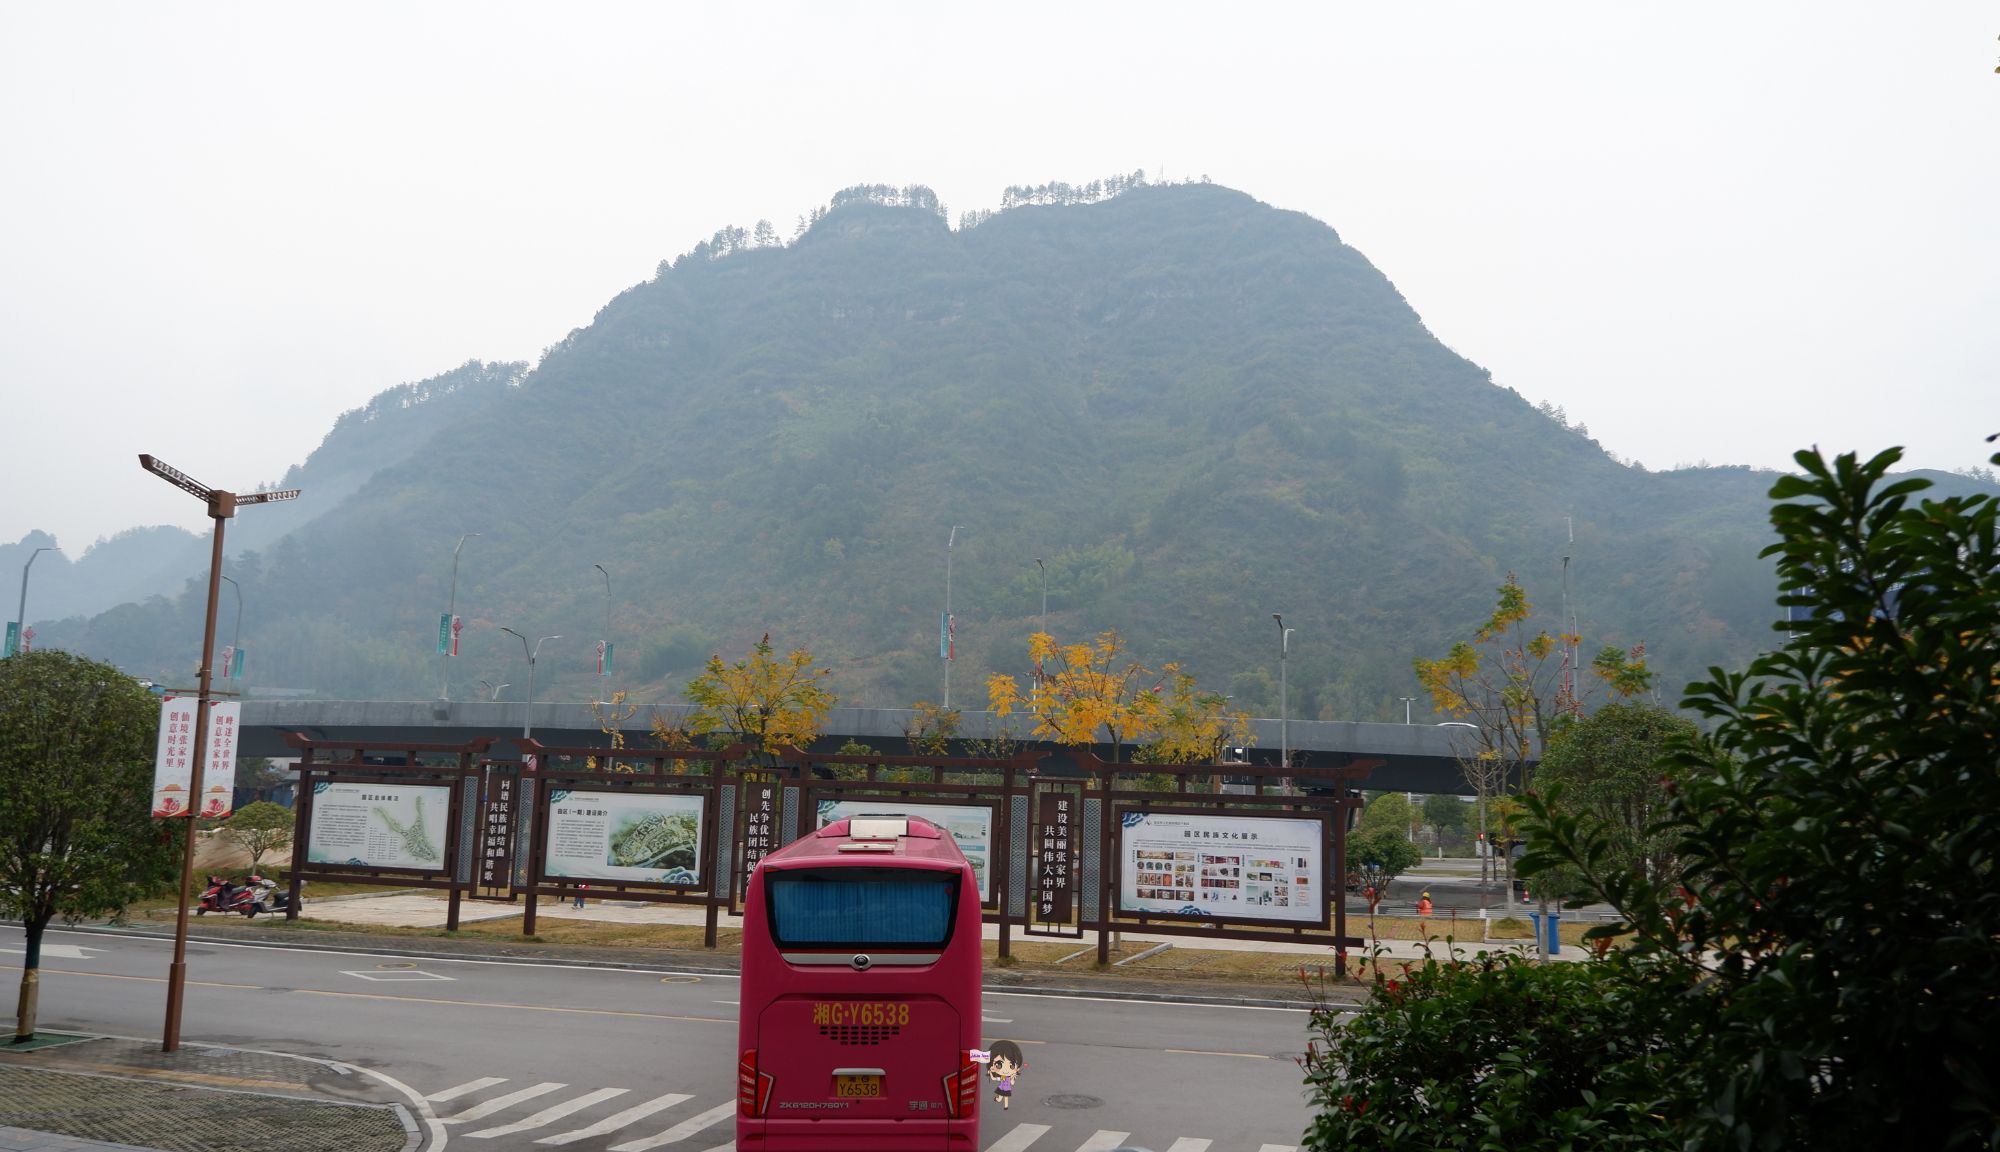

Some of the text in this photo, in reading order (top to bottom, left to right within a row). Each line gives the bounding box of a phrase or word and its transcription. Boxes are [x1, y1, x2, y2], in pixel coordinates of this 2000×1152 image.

[177, 712, 190, 768] 仙境张家界
[211, 716, 224, 770] 创意张家界
[484, 802, 498, 881] 共唱幸福和谐歌
[1056, 800, 1068, 889] 建设美丽张家界
[1184, 830, 1258, 840] 园区民族文化展示
[1042, 825, 1055, 915] 共圆伟大中国梦
[840, 1084, 878, 1096] Y6538
